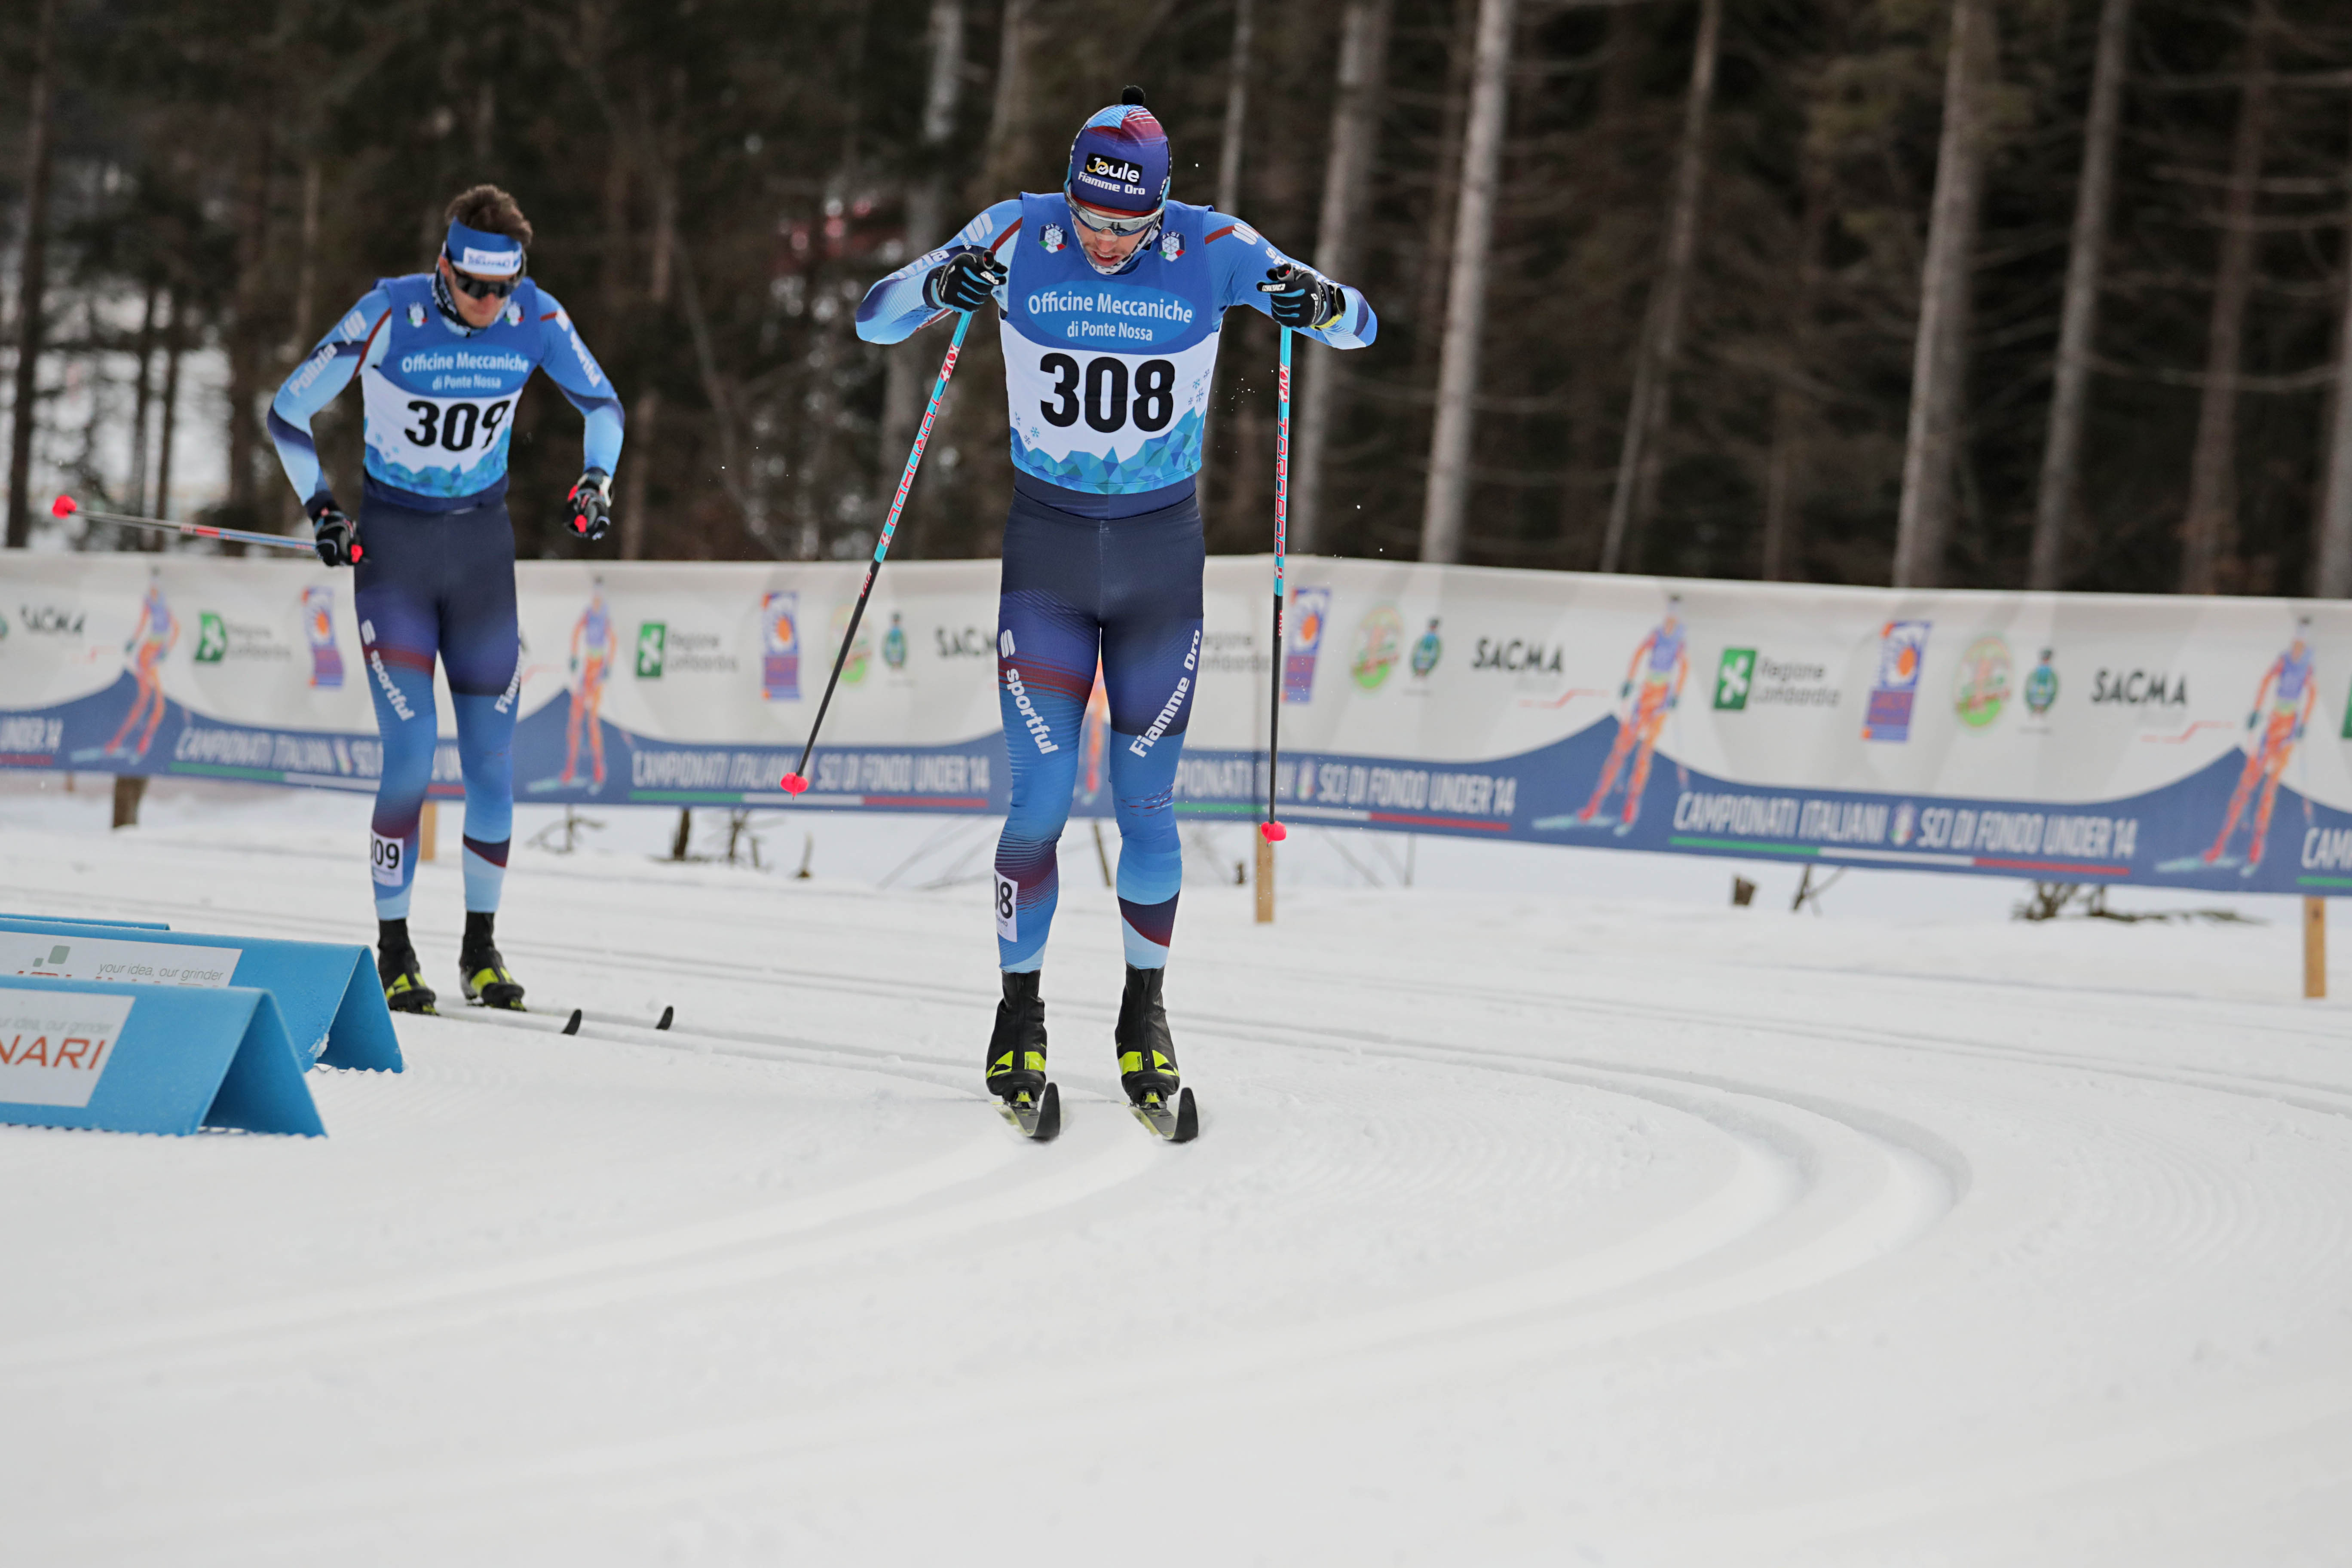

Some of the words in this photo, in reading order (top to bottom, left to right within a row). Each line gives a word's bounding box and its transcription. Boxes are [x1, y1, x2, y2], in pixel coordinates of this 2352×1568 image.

[1078, 171, 1121, 192] Fiamme
[1124, 184, 1145, 195] Oro
[1087, 157, 1139, 182] Joule
[1045, 224, 1063, 233] FISI
[1028, 291, 1093, 314] Officine
[1097, 293, 1193, 323] Meccaniche
[1067, 321, 1078, 337] di
[1081, 321, 1116, 337] Ponte
[1118, 322, 1152, 341] Nossa
[402, 352, 454, 373] Officine
[456, 351, 529, 373] Meccaniche
[432, 375, 443, 390] di
[444, 374, 472, 389] Ponte
[474, 374, 502, 389] Nossa
[1040, 352, 1175, 433] 308
[404, 400, 511, 453] 309
[1471, 636, 1565, 675] SACMA
[371, 650, 415, 721] sportful
[1129, 677, 1190, 758] Fiamme
[1184, 630, 1200, 671] Oro
[2090, 667, 2188, 707] SACMA
[1006, 668, 1059, 755] sportful
[1368, 766, 1429, 810] FONDO
[1428, 771, 1494, 815] UNDER
[1493, 775, 1517, 817] 14
[1672, 791, 1801, 838] CAMPIONATI
[1798, 799, 1889, 844] ITALIANI
[1916, 807, 1955, 848] SCI
[1950, 808, 1977, 850] DI
[1974, 811, 2045, 854] FONDO
[2043, 814, 2113, 859] UNDER
[2112, 818, 2138, 860] 14
[371, 832, 399, 869] 09
[98, 962, 126, 975] your
[128, 963, 155, 977] idea,
[159, 966, 179, 977] our
[181, 968, 224, 982] grinder
[0, 1034, 106, 1070] NARI
